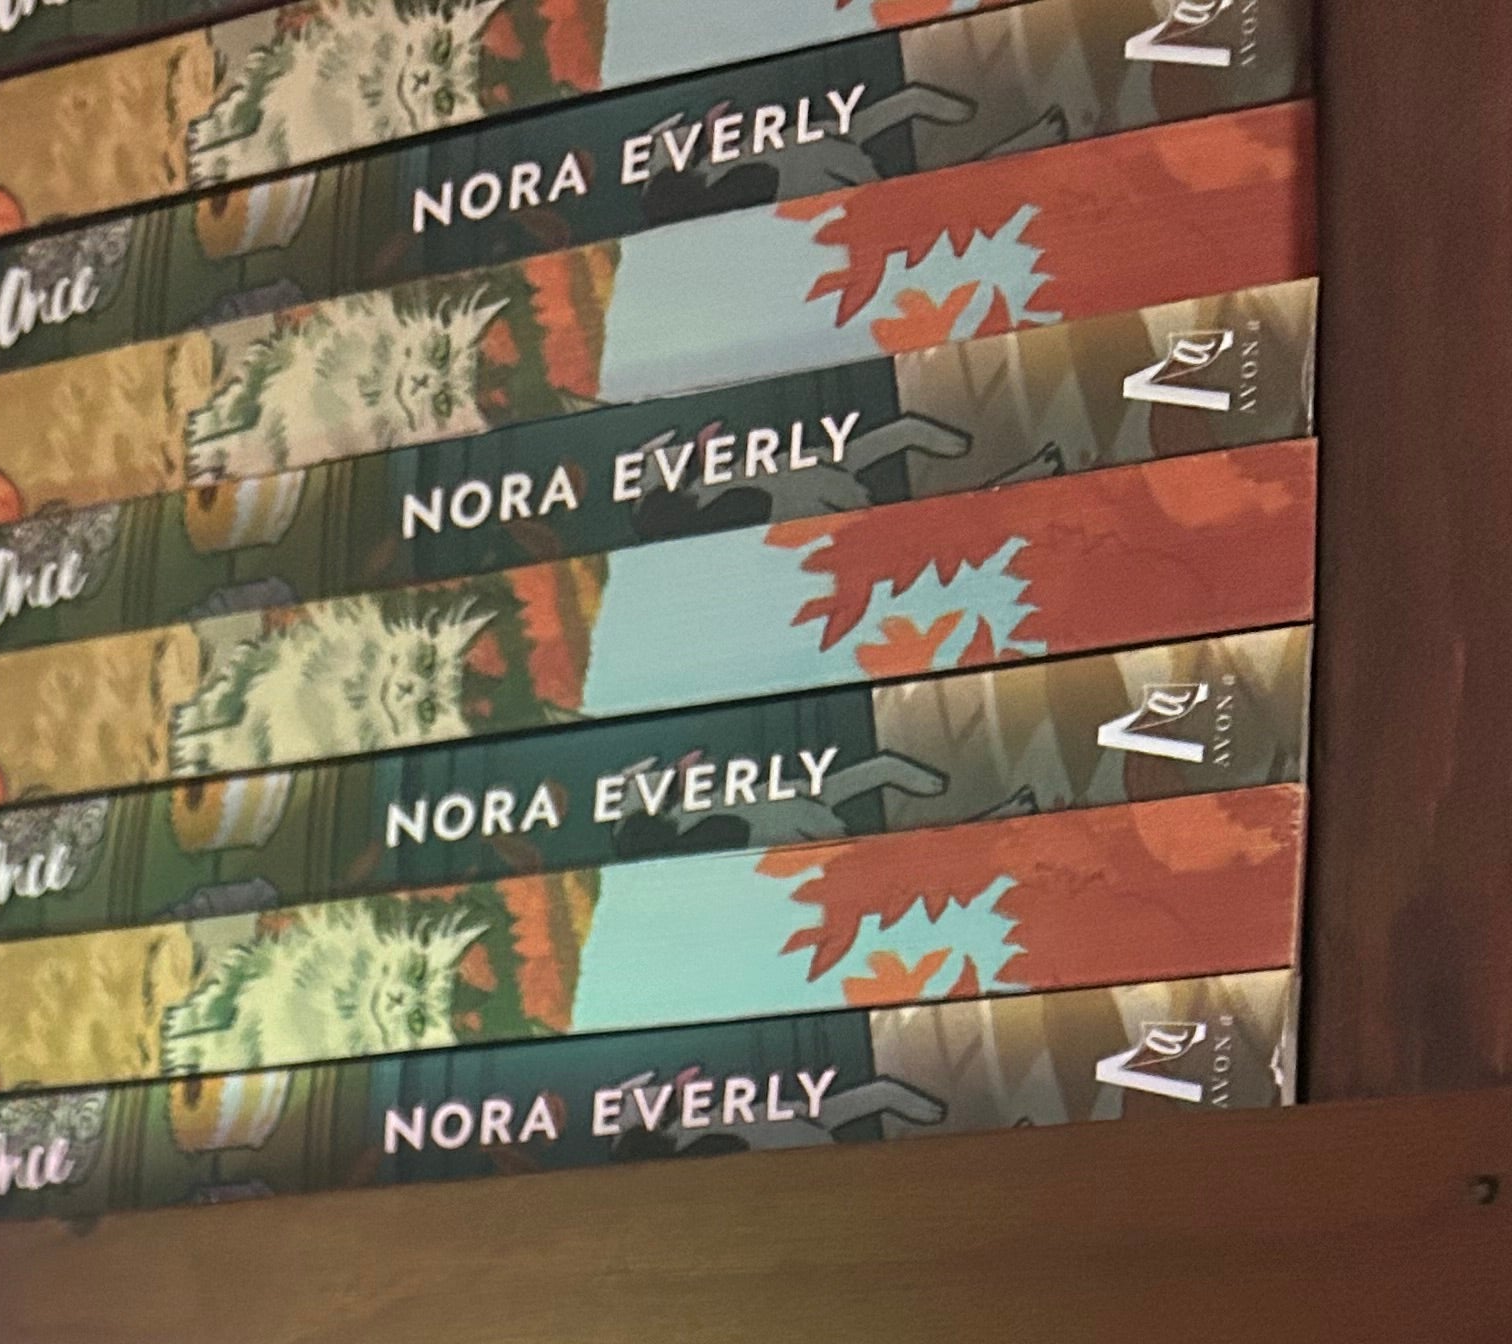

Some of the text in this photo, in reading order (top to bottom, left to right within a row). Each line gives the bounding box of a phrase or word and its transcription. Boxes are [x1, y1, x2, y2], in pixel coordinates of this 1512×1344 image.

[412, 83, 866, 233] NORA EVERLY
[401, 411, 860, 541] NORA EVERLY
[386, 746, 839, 849] NORA EVERLY
[383, 1065, 838, 1154] NORA EVERLY
